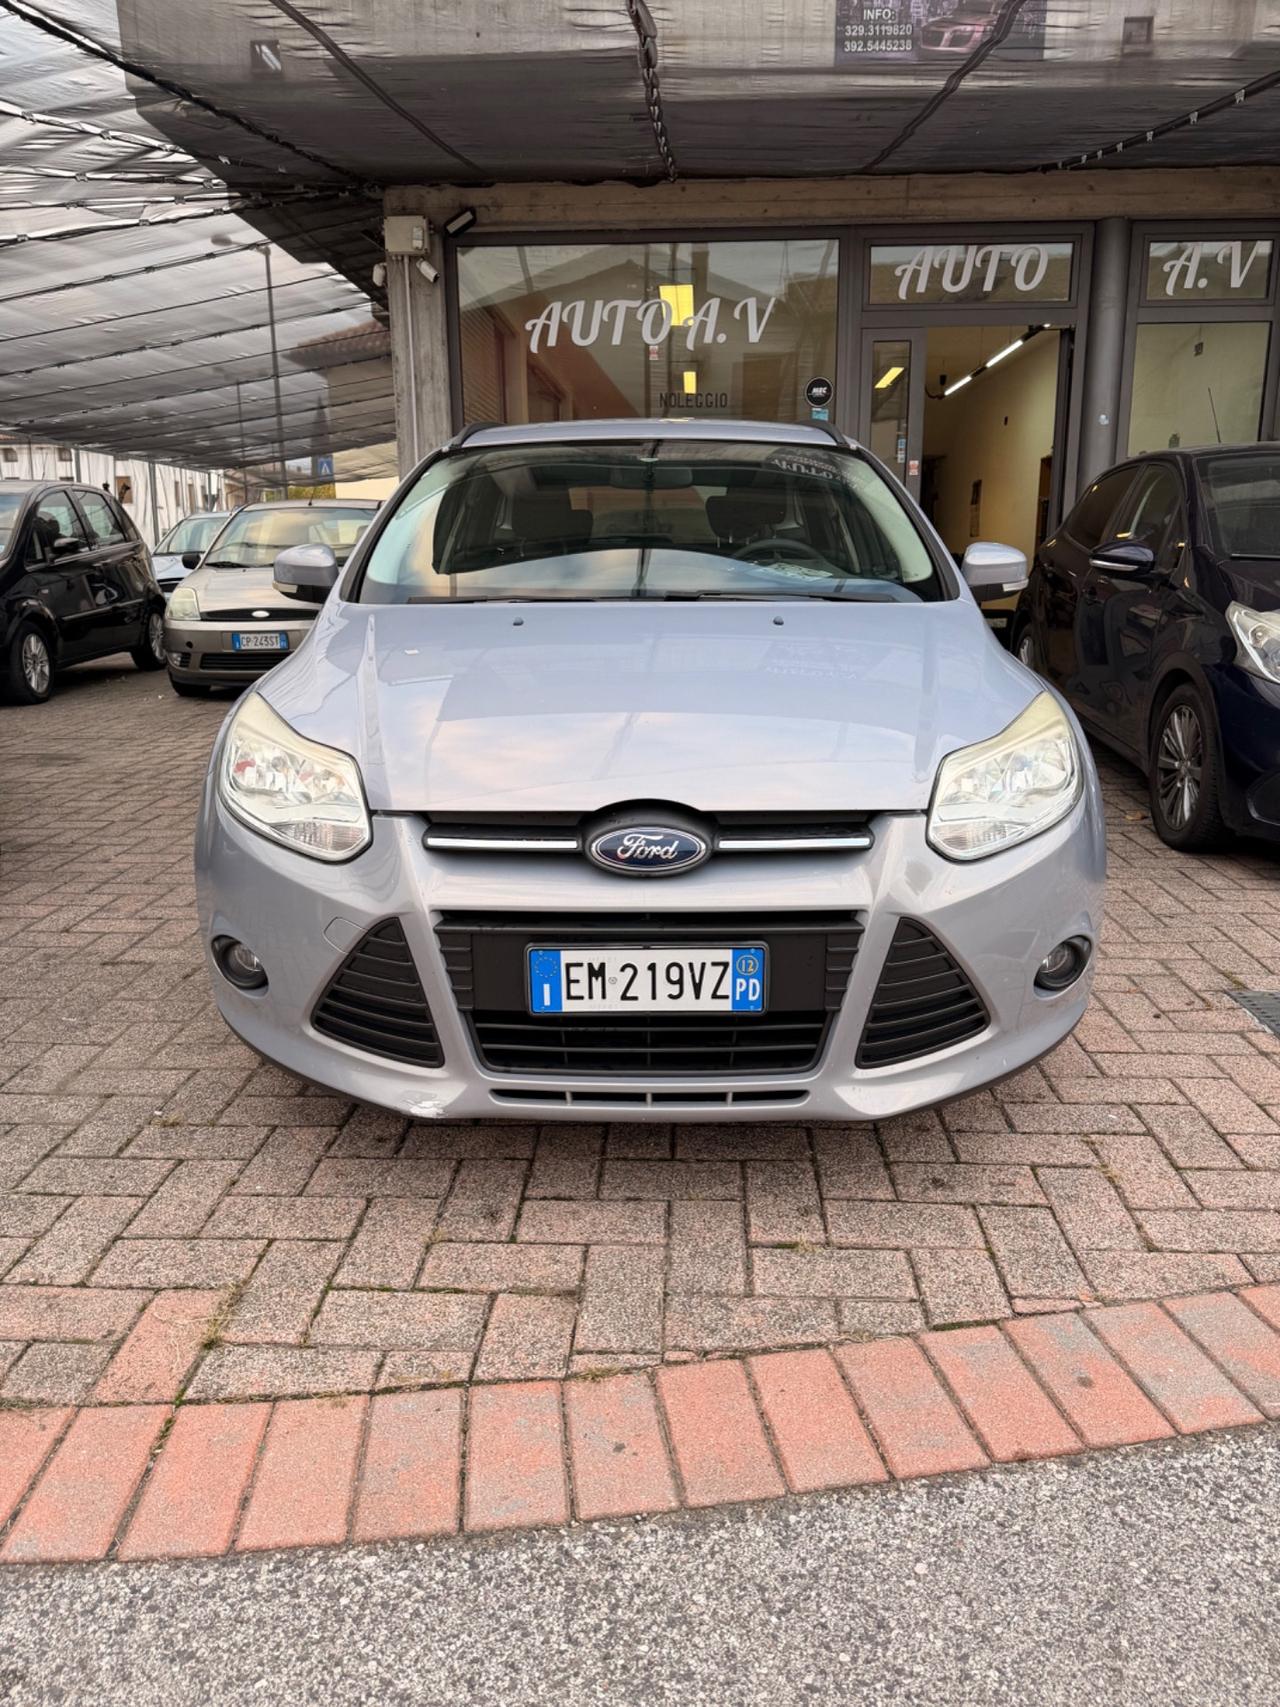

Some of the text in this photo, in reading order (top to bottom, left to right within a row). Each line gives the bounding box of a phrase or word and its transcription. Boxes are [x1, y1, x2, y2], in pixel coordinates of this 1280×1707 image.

[863, 9, 895, 20] INFO:
[894, 245, 1048, 300] AUTO
[525, 298, 673, 354] AUTO
[658, 392, 728, 408] NOLEGGIO
[616, 833, 680, 860] Ford
[740, 957, 755, 973] 12
[735, 977, 761, 1001] PD
